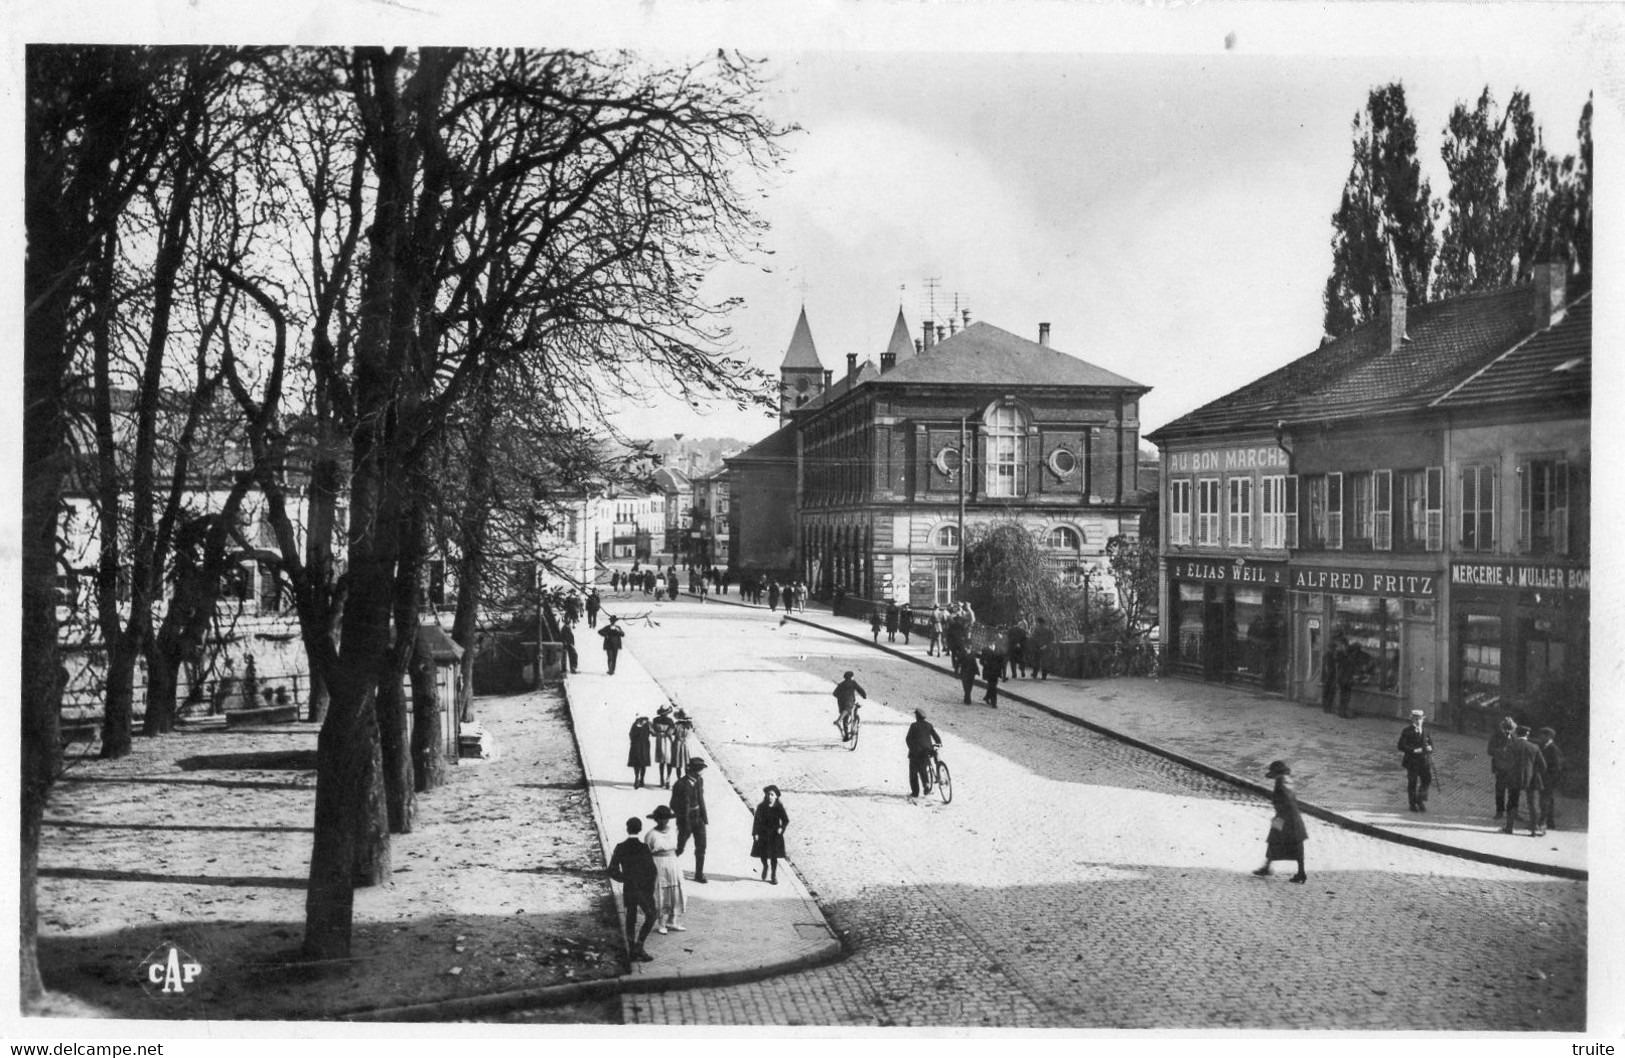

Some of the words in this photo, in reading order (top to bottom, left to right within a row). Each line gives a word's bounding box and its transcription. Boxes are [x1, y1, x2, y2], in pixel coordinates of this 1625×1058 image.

[1171, 454, 1187, 471] AU
[1193, 451, 1219, 470] BON
[1225, 447, 1287, 468] MARCHE
[1187, 562, 1226, 579] ELIAS
[1232, 564, 1267, 582] WEIL
[1296, 571, 1364, 590] ALFRED
[1373, 574, 1433, 594] FRITZ
[1452, 564, 1503, 585] MERCERIE
